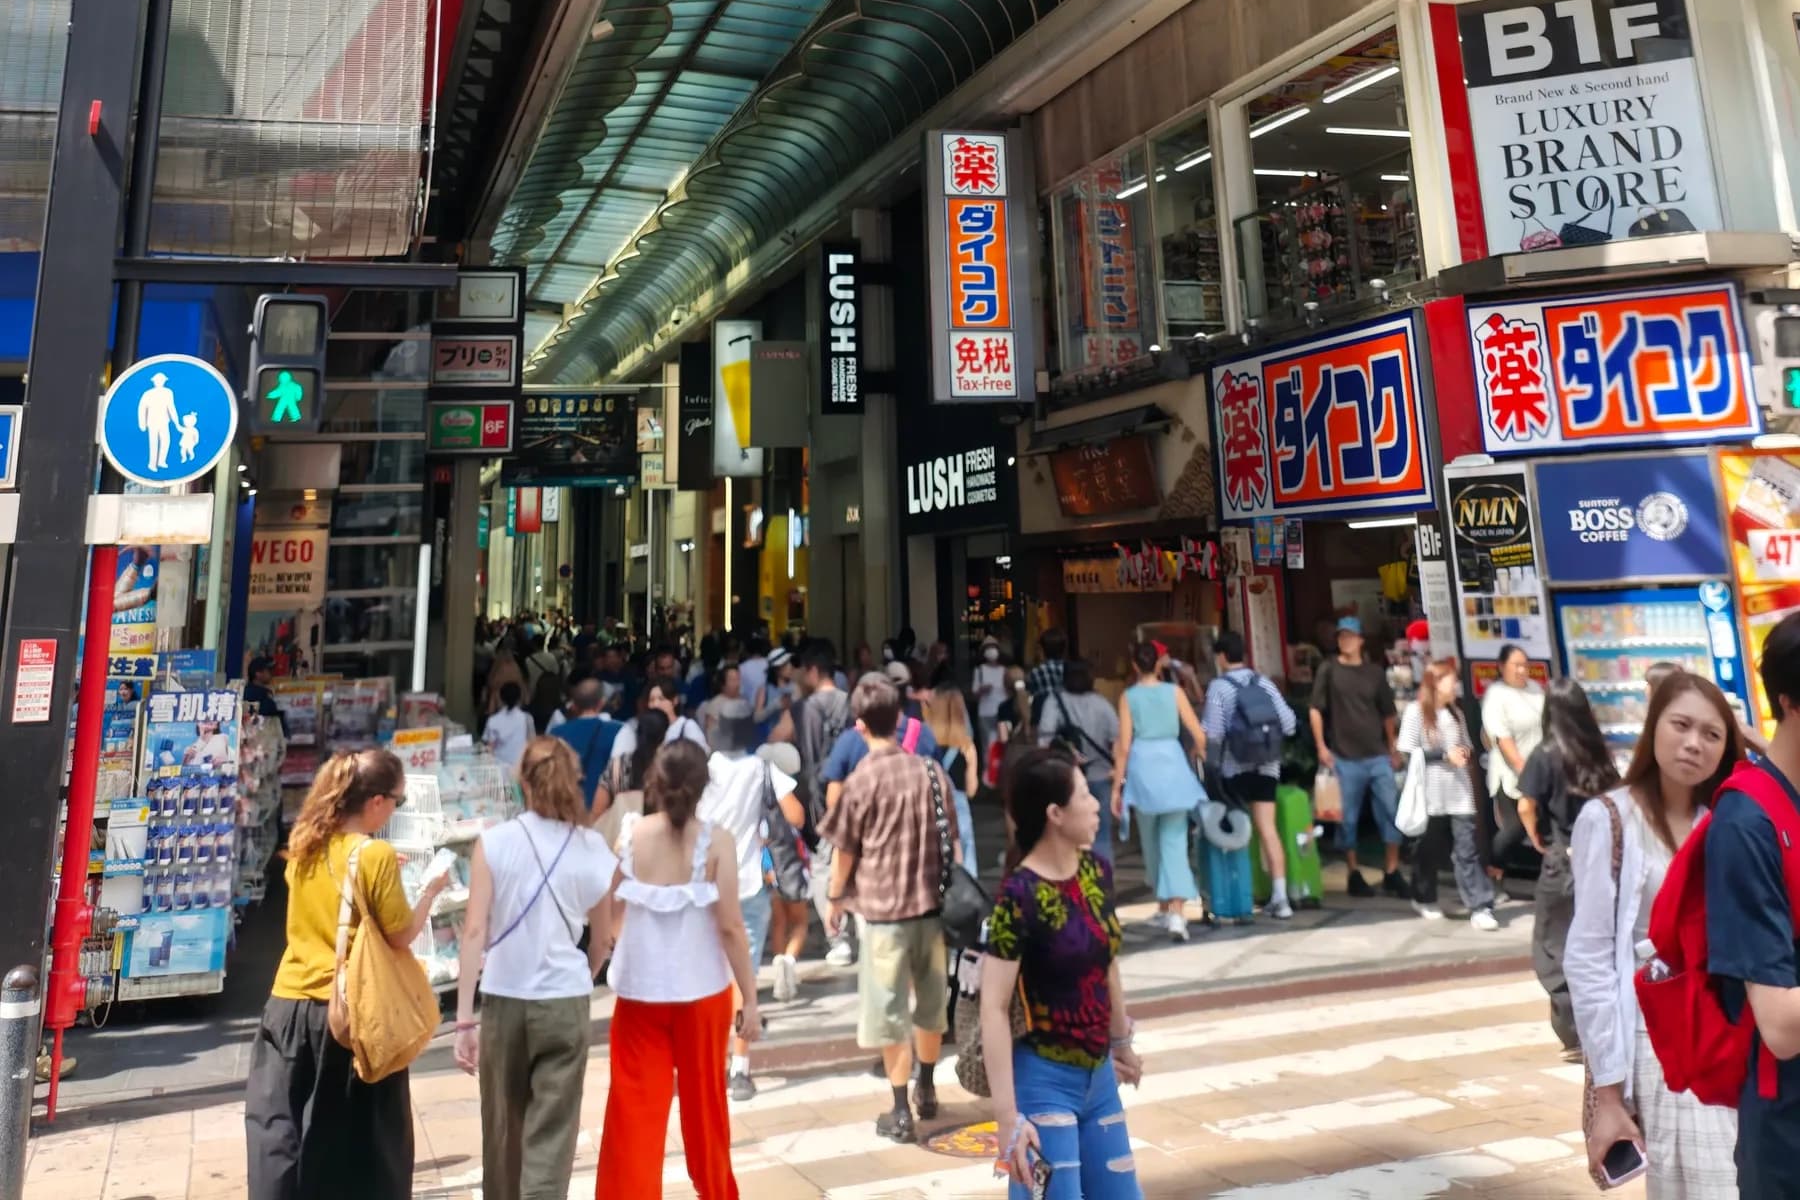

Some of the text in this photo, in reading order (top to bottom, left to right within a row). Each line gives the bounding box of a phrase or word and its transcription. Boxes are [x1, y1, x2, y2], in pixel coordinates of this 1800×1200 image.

[1494, 71, 1670, 106] Brand New & Second hand
[1515, 94, 1659, 137] LUXURY
[951, 137, 998, 191] 薬
[1501, 124, 1683, 180] BRAND
[1508, 166, 1688, 221] STORE
[958, 204, 998, 323] ダイコク
[828, 253, 857, 352] LUSH
[954, 336, 1011, 374] 免税
[1478, 305, 1737, 438] 薬 ダイコク
[846, 357, 857, 403] FRESH
[956, 376, 1012, 391] Tax-Free
[484, 419, 506, 434] 6F
[1218, 349, 1412, 509] 薬 ダイコク
[907, 445, 996, 515] LUSH FRESH
[1458, 496, 1520, 528] NMN
[1568, 507, 1635, 531] BOSS
[1578, 498, 1620, 508] SUNTORY
[1419, 524, 1442, 557] B1F
[1579, 530, 1629, 543] COFFEE
[107, 655, 155, 677] 生堂
[149, 691, 236, 723] 雪肌精
